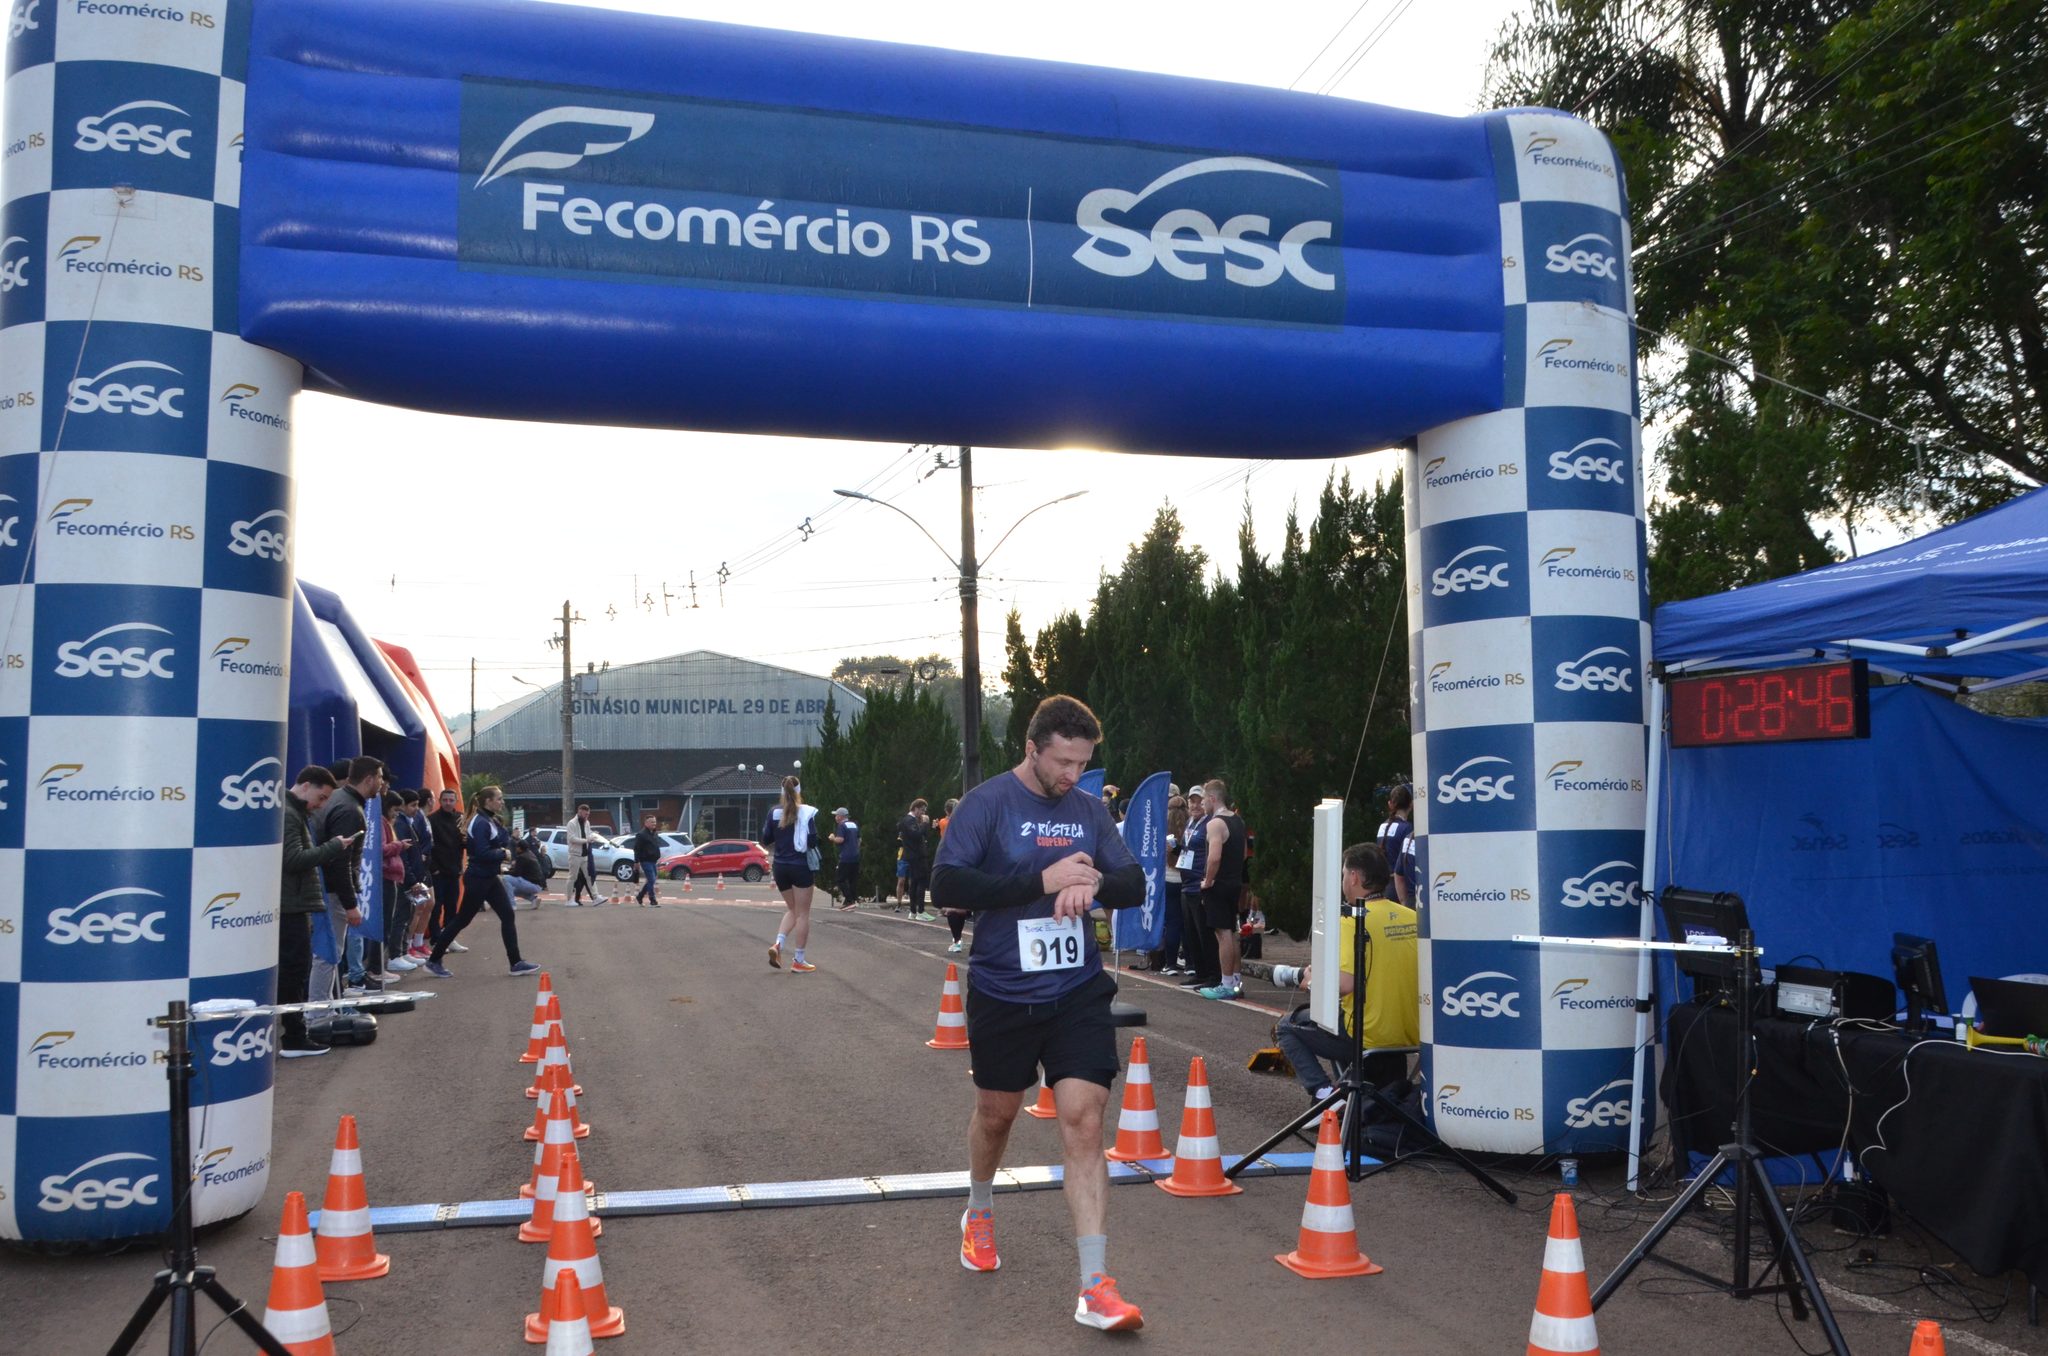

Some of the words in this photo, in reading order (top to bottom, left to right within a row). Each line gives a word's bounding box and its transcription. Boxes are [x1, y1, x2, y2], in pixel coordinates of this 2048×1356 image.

[77, 1, 184, 22] Fecomércio
[190, 12, 215, 29] RS
[29, 132, 45, 149] RS
[74, 112, 192, 159] Sesc
[1533, 153, 1601, 172] Fecomércio
[523, 182, 891, 258] Fecomércio
[912, 215, 991, 266] RS
[1072, 186, 1335, 290] Sesc
[66, 257, 172, 278] Fecomércio
[178, 265, 204, 282] RS
[1545, 244, 1617, 281] Sesc
[1545, 357, 1615, 373] Fecomércio
[1617, 363, 1628, 376] RS
[17, 391, 35, 407] RS
[65, 376, 184, 418] Sesc
[1426, 467, 1494, 490] Fecomércio
[1498, 463, 1518, 476] RS
[1547, 450, 1624, 484] Sesc
[56, 521, 164, 538] Fecomércio
[170, 524, 195, 540] RS
[1431, 562, 1509, 596] Sesc
[1548, 566, 1621, 580] Fecomércio
[1624, 569, 1635, 581] RS
[7, 654, 24, 669] RS
[54, 640, 174, 678] Sesc
[1432, 675, 1500, 693] Fecomércio
[1505, 673, 1525, 686] RS
[1554, 661, 1632, 692] Sesc
[572, 697, 640, 714] GINÁSIO
[646, 699, 737, 714] MUNICIPAL
[743, 699, 764, 714] 29
[769, 699, 790, 714] DE
[796, 699, 841, 714] ABRL
[47, 786, 154, 801] Fecomércio
[160, 786, 186, 801] RS
[1437, 774, 1515, 804] Sesc
[1554, 778, 1629, 792] Fecomércio
[1631, 779, 1643, 792] RS
[1037, 820, 1084, 838] RÚSTICA
[1141, 799, 1151, 858] Fecomércio
[1437, 888, 1506, 902] Fecomércio
[1510, 888, 1531, 901] RS
[1561, 877, 1640, 908] Sesc
[45, 907, 165, 945] Sesc
[1030, 936, 1078, 967] 919
[1441, 986, 1520, 1018] Sesc
[1560, 995, 1635, 1010] Fecomércio
[38, 1052, 146, 1068] Fecomércio
[1441, 1102, 1510, 1120] Fecomércio
[1514, 1108, 1535, 1121] RS
[37, 1174, 158, 1213] Sesc
